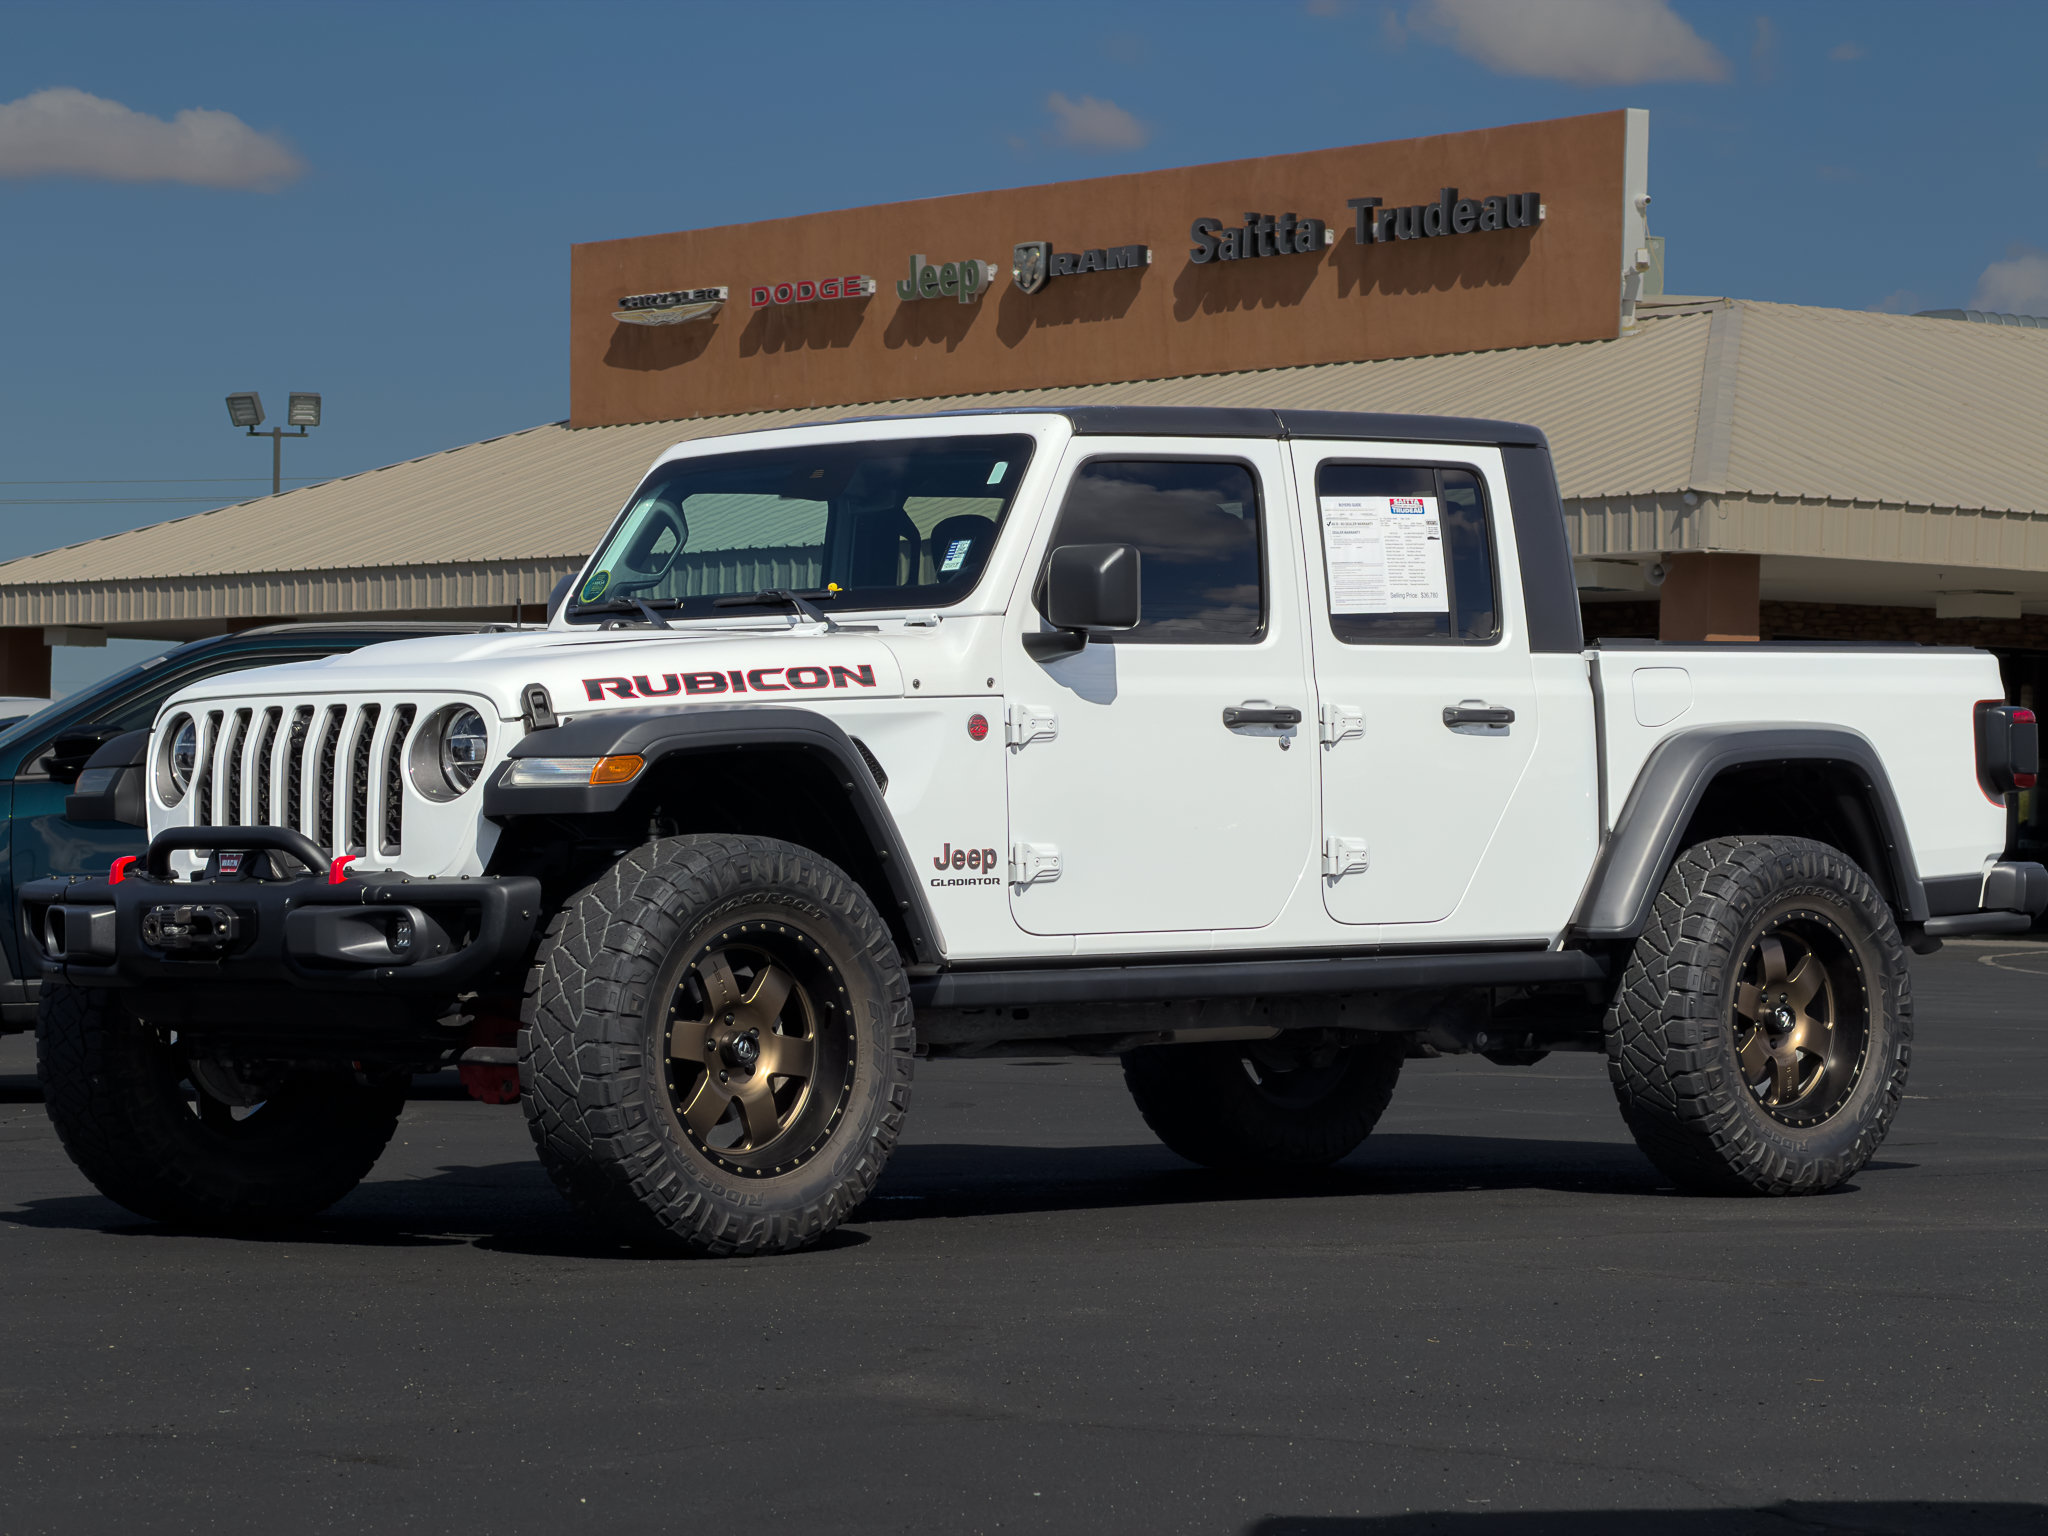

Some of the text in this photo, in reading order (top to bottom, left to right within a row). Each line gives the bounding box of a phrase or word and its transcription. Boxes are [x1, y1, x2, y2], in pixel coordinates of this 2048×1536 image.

[1190, 188, 1540, 264] Saitta Trudeau
[1050, 246, 1143, 276] RAM
[751, 275, 862, 308] DODGE
[896, 254, 981, 302] Jeep
[582, 664, 876, 702] RUBICON
[933, 842, 997, 875] Jeep
[930, 877, 1001, 886] GLADIATOR
